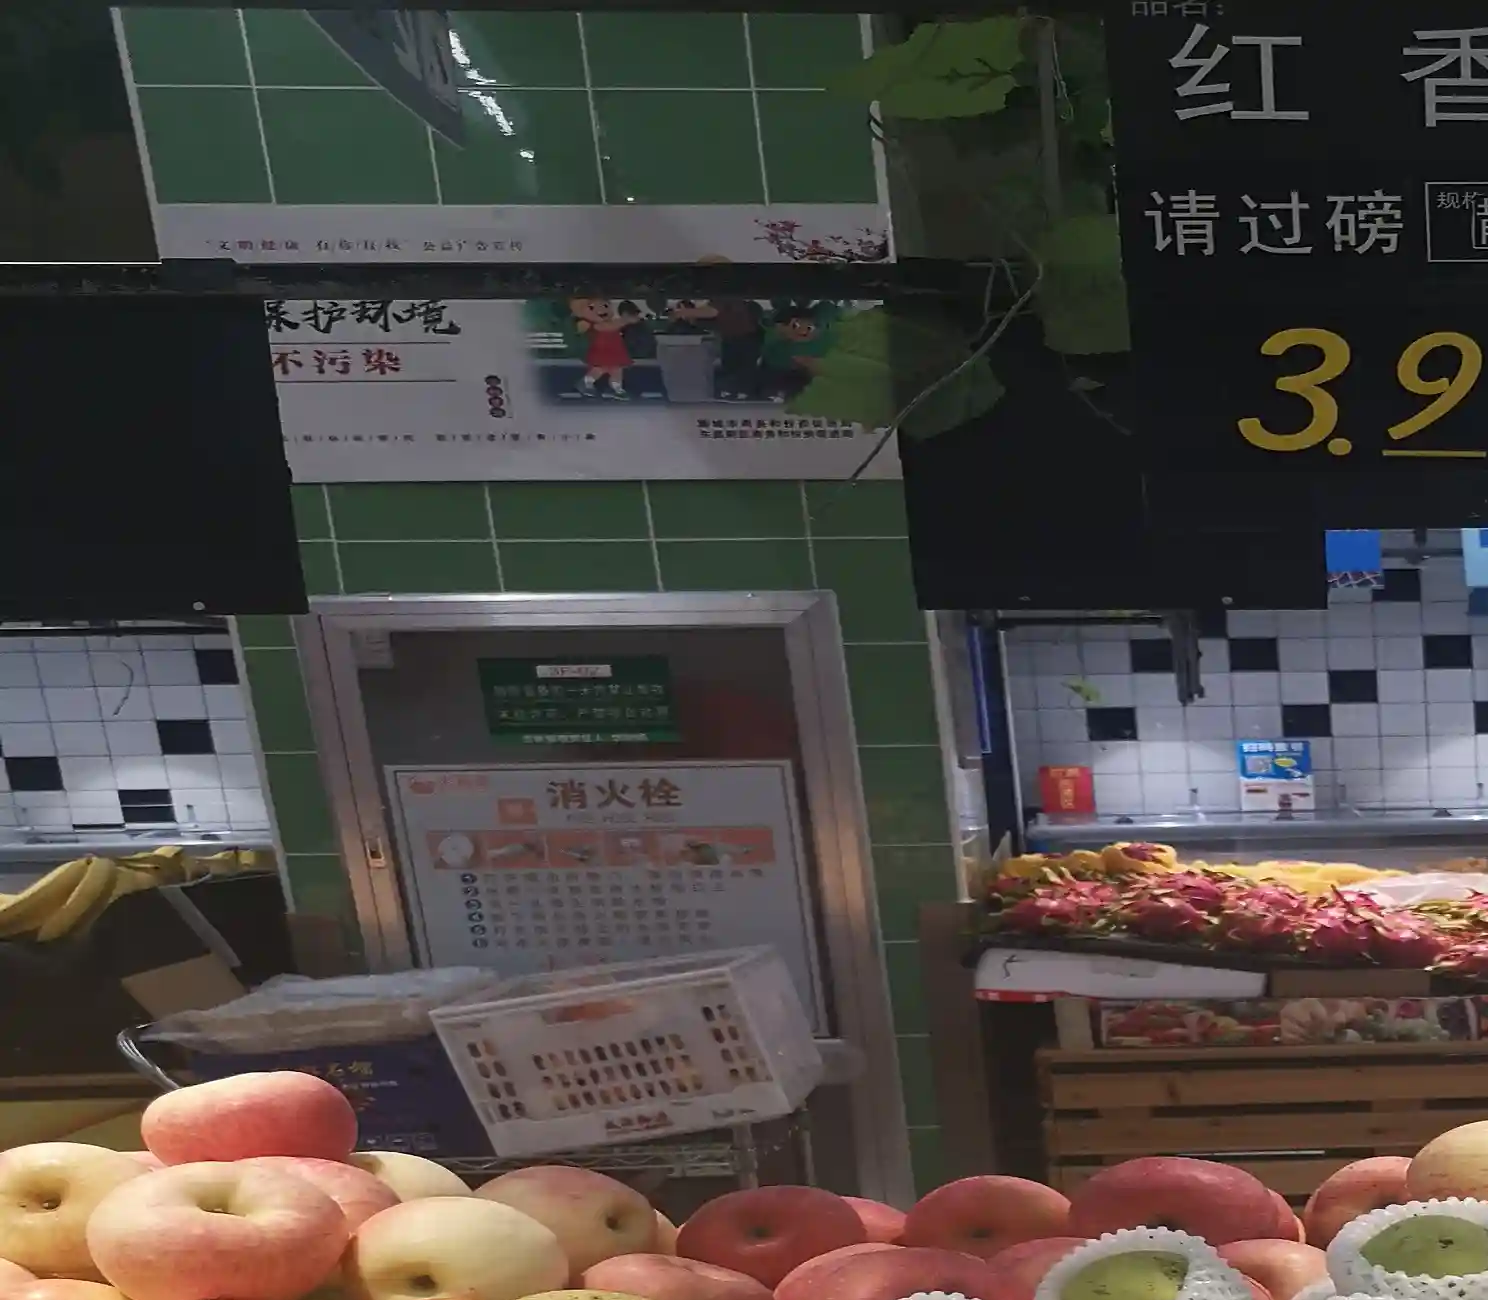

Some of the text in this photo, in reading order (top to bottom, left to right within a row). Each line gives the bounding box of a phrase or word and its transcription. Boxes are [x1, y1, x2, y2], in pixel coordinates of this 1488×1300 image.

[1144, 189, 1404, 256] 请过磅
[273, 348, 402, 376] 不污染
[546, 777, 683, 809] 消火栓
